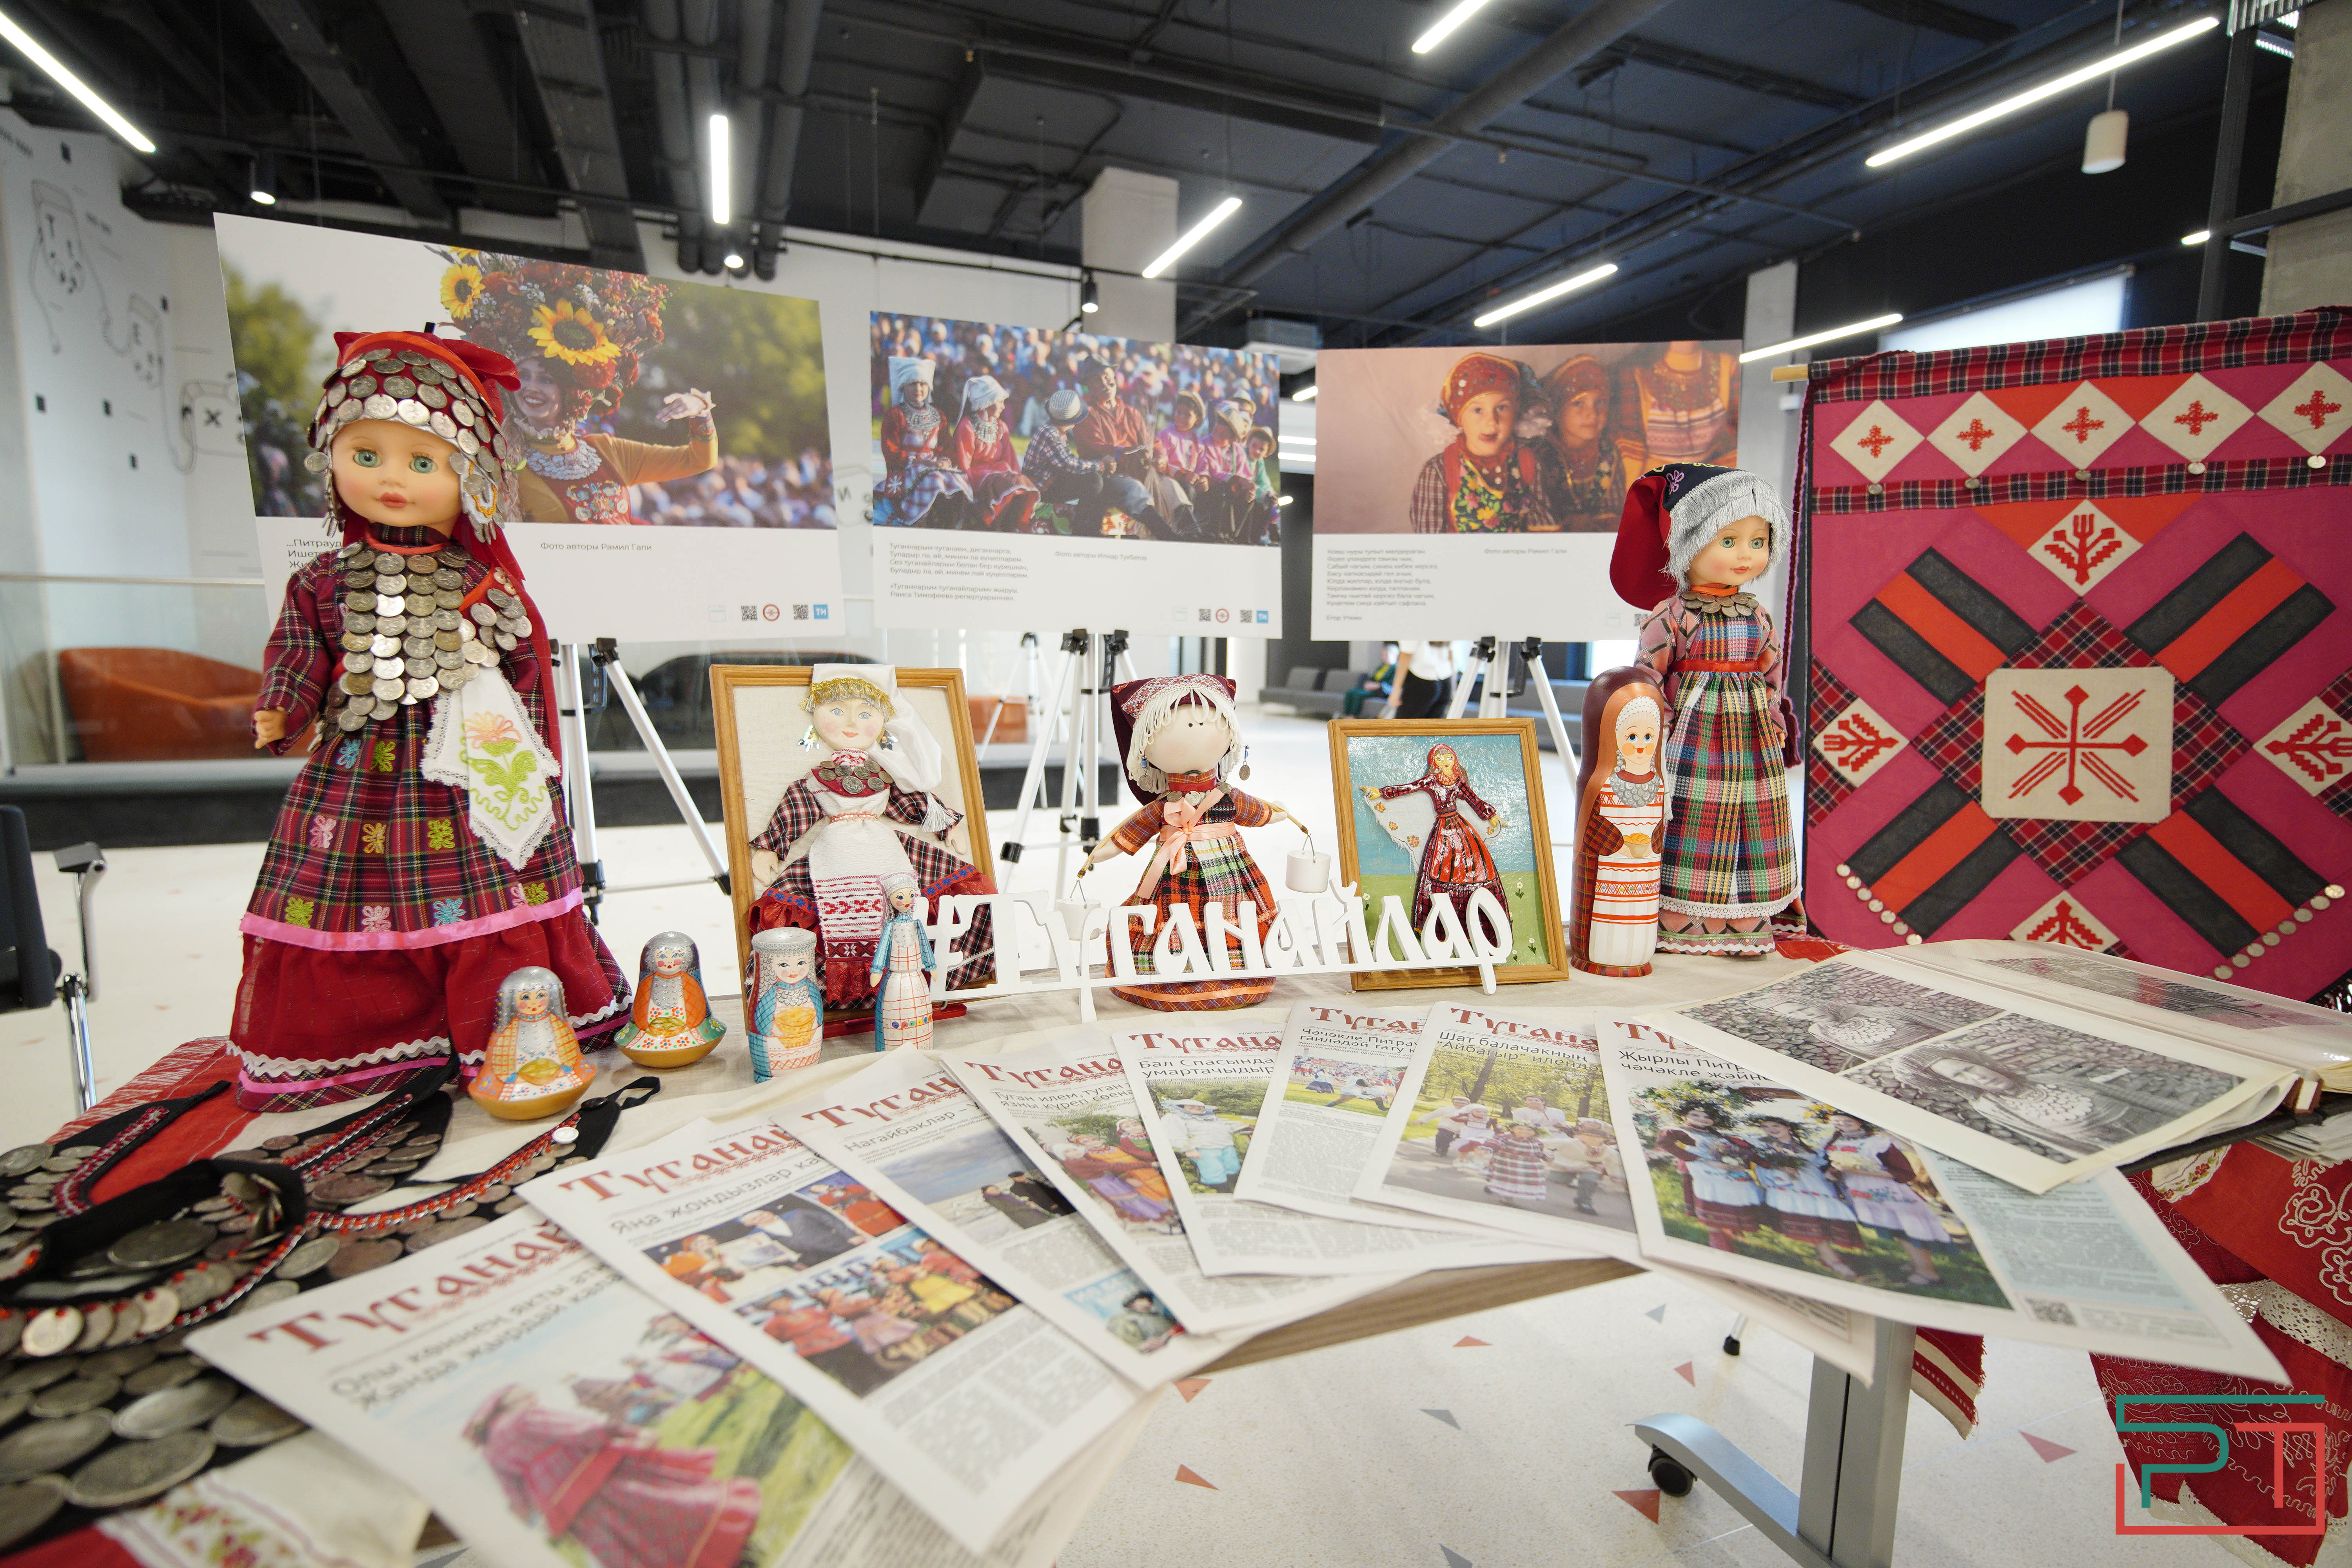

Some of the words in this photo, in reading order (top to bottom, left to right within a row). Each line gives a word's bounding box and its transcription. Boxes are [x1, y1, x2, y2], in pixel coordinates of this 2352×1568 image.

[1302, 1028, 1363, 1041] Чәчәкле
[1300, 1035, 1368, 1047] гаиләдәй
[1373, 1043, 1404, 1053] тату
[1437, 1041, 1526, 1061] “Айбагыр”
[1439, 1032, 1474, 1043] Шат
[1479, 1037, 1587, 1062] балачакның
[1180, 1057, 1274, 1066] Спасында
[1619, 1050, 1690, 1065] Җырлы
[1621, 1063, 1700, 1077] чәчәкле
[991, 1091, 1035, 1102] Туган
[1038, 1093, 1083, 1102] илем,
[1082, 1083, 1123, 1095] туган
[1001, 1100, 1039, 1109] язны
[844, 1110, 956, 1152] Нагайбәкләр
